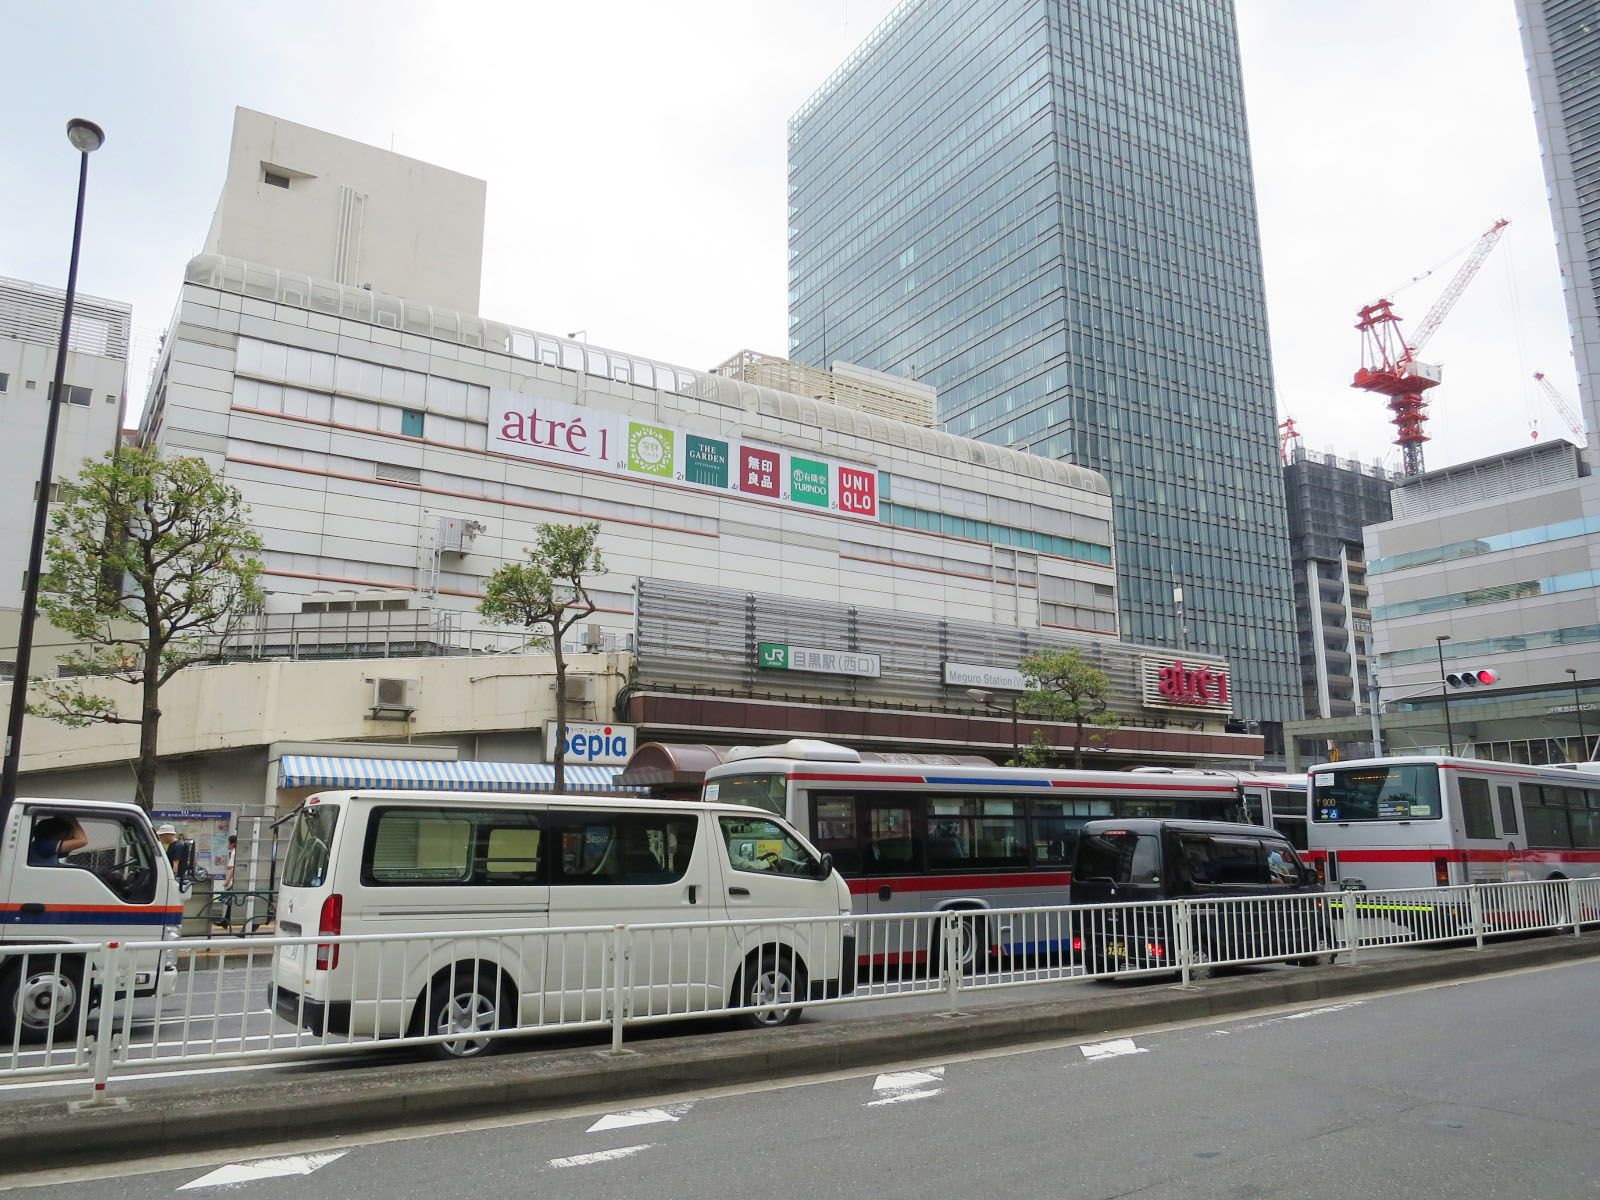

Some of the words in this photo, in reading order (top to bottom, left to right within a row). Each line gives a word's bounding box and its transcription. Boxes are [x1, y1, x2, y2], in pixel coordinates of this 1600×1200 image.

[501, 408, 588, 452] atré
[699, 444, 717, 455] THE
[689, 450, 725, 464] GARDEN
[748, 456, 773, 473] 無印
[676, 472, 686, 481] 2F
[748, 472, 773, 489] 良品
[842, 473, 869, 493] UNI
[731, 483, 740, 491] 4F
[793, 481, 827, 496] YURINDO
[782, 492, 791, 501] 5F
[843, 491, 872, 510] QLO
[831, 501, 839, 510] 5F
[764, 648, 785, 663] JR
[949, 670, 982, 684] Meguro
